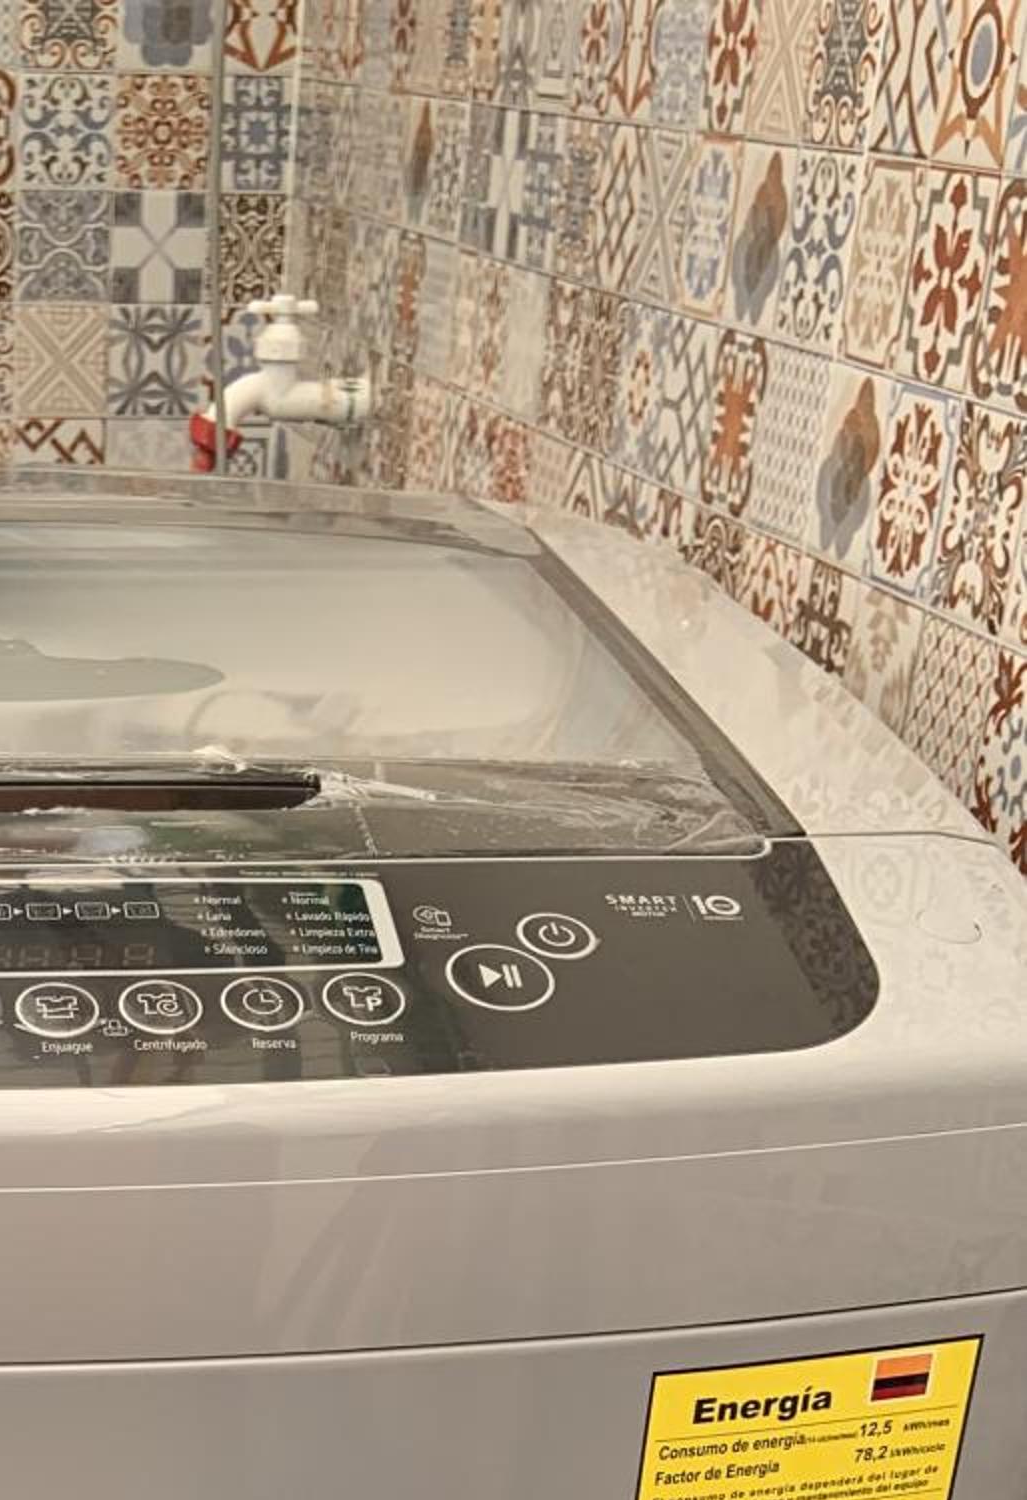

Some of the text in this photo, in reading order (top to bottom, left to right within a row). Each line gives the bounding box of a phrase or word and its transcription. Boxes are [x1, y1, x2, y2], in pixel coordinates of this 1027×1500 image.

[202, 896, 242, 906] Normal
[289, 896, 331, 906] Normal
[604, 893, 676, 905] SMART
[206, 912, 232, 922] Lana
[294, 911, 332, 922] Lavado
[209, 928, 266, 939] Edredones
[299, 927, 346, 940] Limpieza
[212, 944, 268, 955] Silencioso
[302, 943, 344, 957] Limpieza
[252, 1038, 297, 1050] Reserva
[350, 1031, 404, 1045] Programa
[41, 1041, 94, 1055] Enjuague
[133, 1040, 208, 1054] Centrifugado
[692, 1386, 833, 1425] Energía
[860, 1419, 894, 1438] 12,5
[658, 1441, 728, 1461] Consumo
[732, 1439, 750, 1453] de
[752, 1432, 806, 1451] energía
[854, 1445, 888, 1464] 78,2
[655, 1460, 780, 1486] Factor de Energía
[730, 1489, 746, 1500] de
[749, 1482, 796, 1497] energía
[800, 1475, 864, 1492] dependerá
[867, 1471, 886, 1483] del
[889, 1467, 921, 1482] lugar
[924, 1464, 939, 1475] de
[875, 1483, 892, 1494] del
[893, 1479, 929, 1493] equipo
